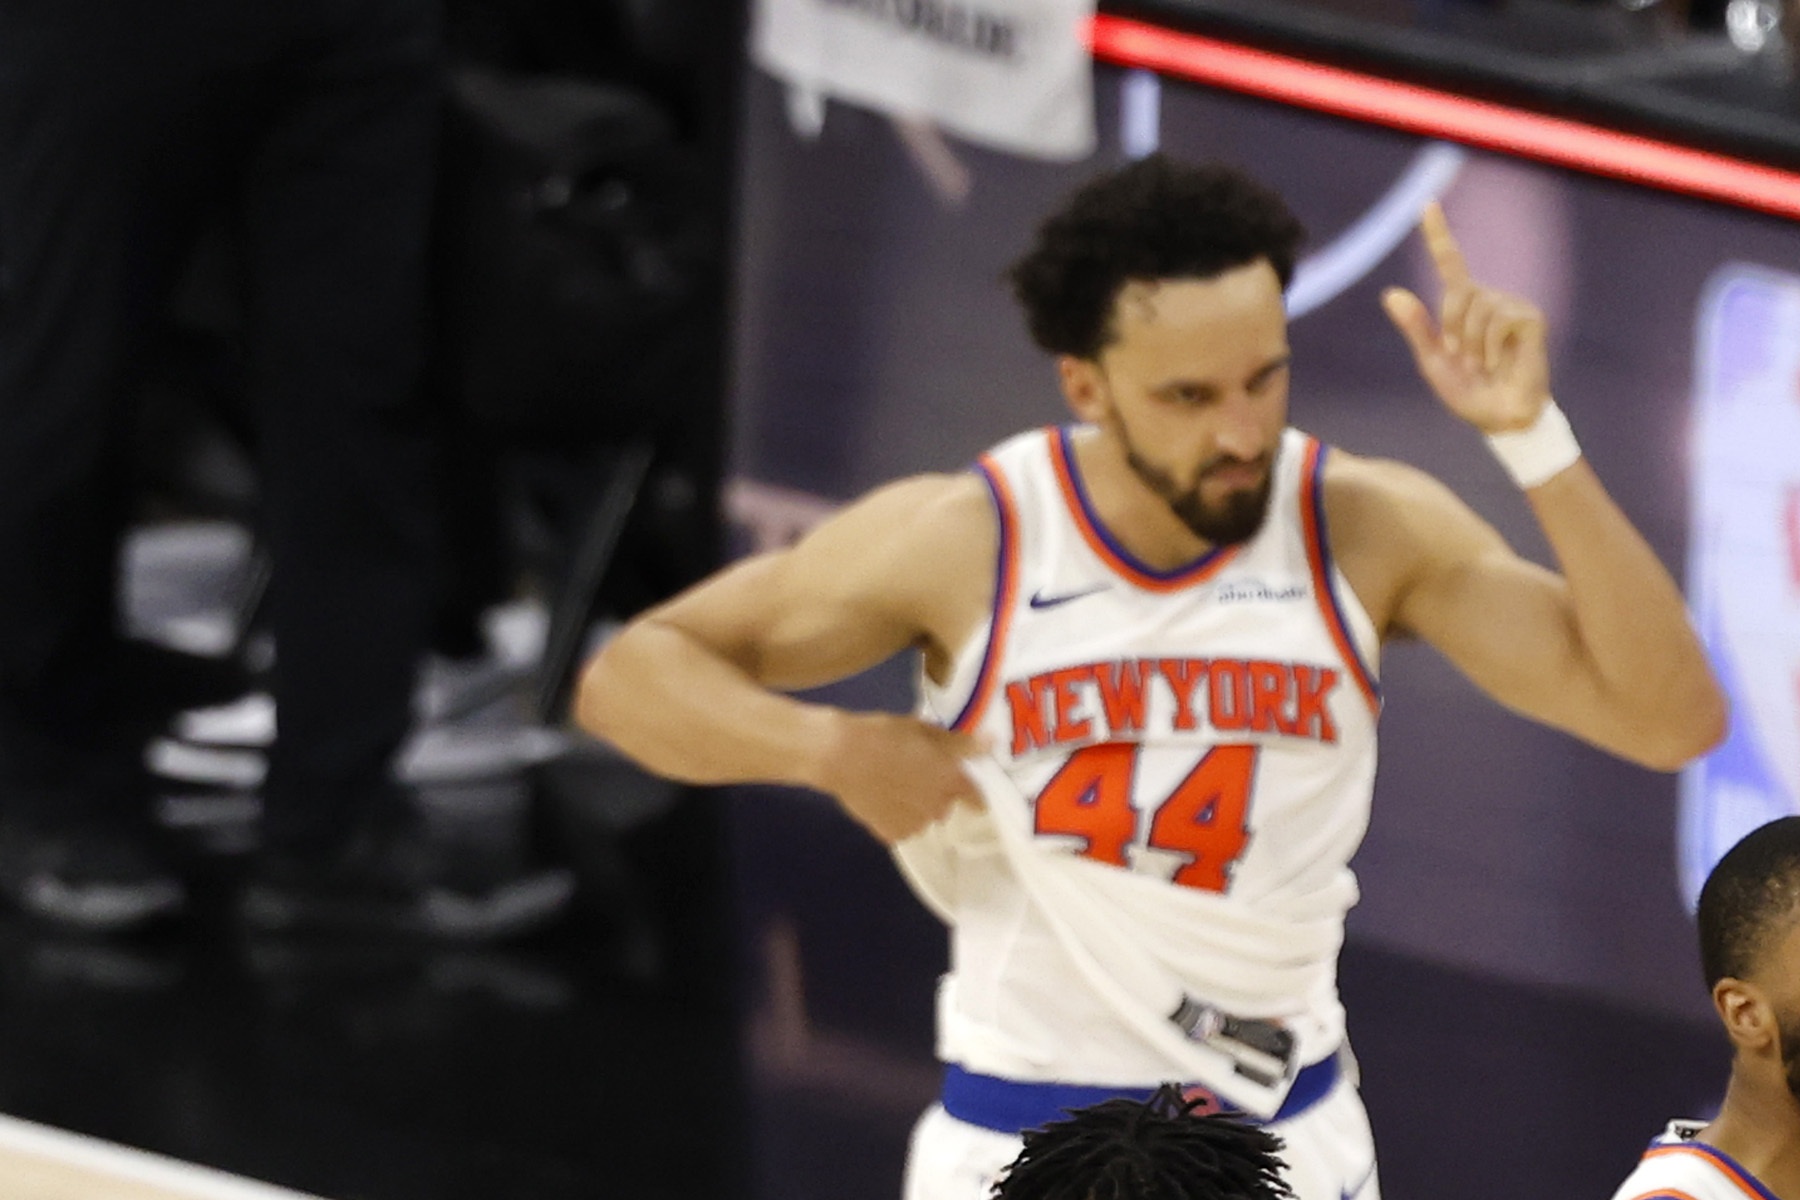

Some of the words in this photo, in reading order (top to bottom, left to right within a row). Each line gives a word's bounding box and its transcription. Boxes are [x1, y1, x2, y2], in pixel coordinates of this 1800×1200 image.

[1005, 657, 1151, 758] NEW
[1157, 657, 1342, 746] YORK
[1033, 742, 1261, 897] 44
